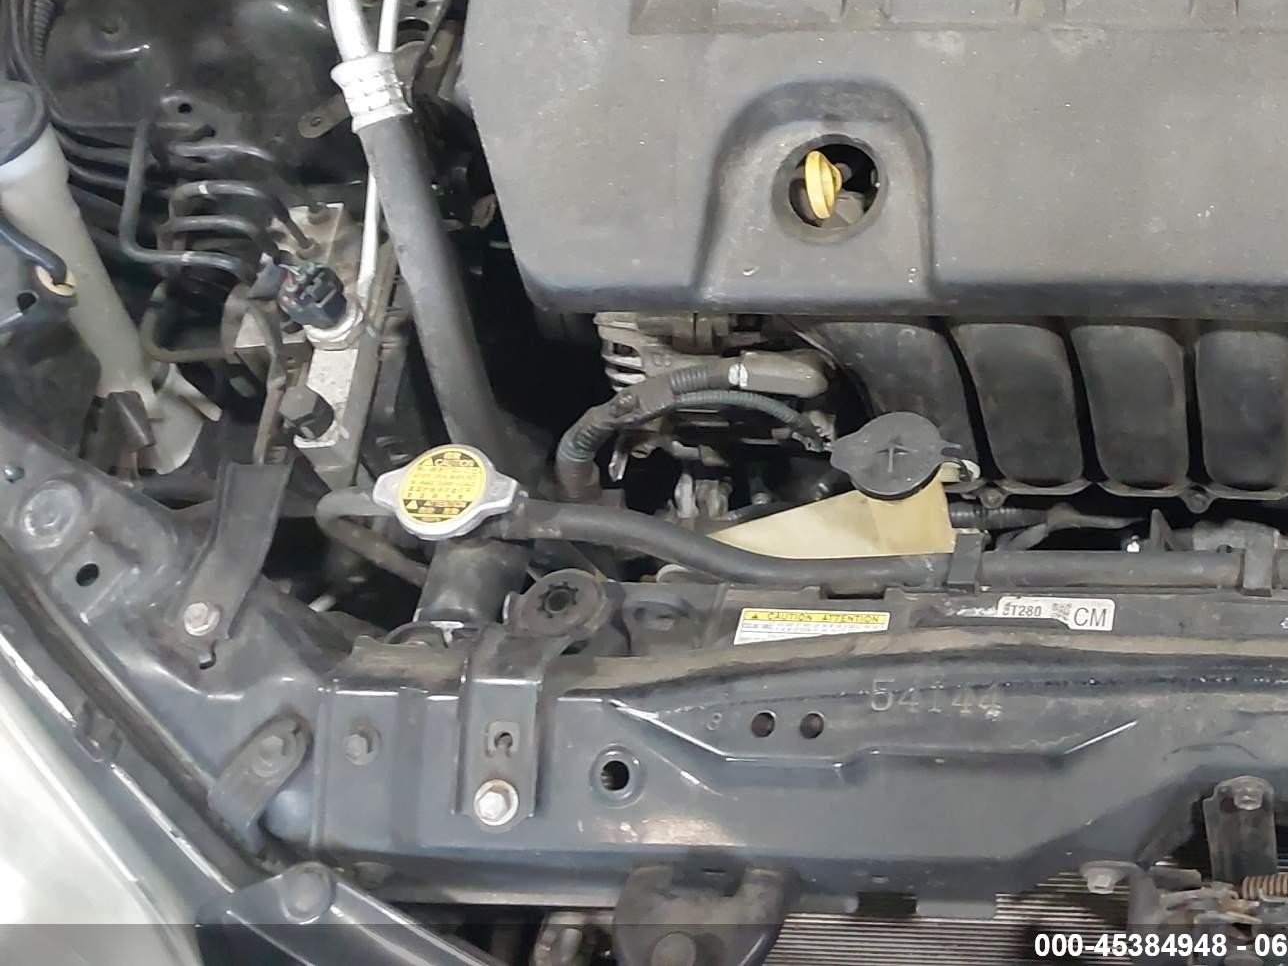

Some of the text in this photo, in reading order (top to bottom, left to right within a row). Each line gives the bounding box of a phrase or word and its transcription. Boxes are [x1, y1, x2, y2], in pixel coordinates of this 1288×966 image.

[767, 611, 881, 624] CAUTION ATTENTION
[1073, 607, 1107, 627] CM
